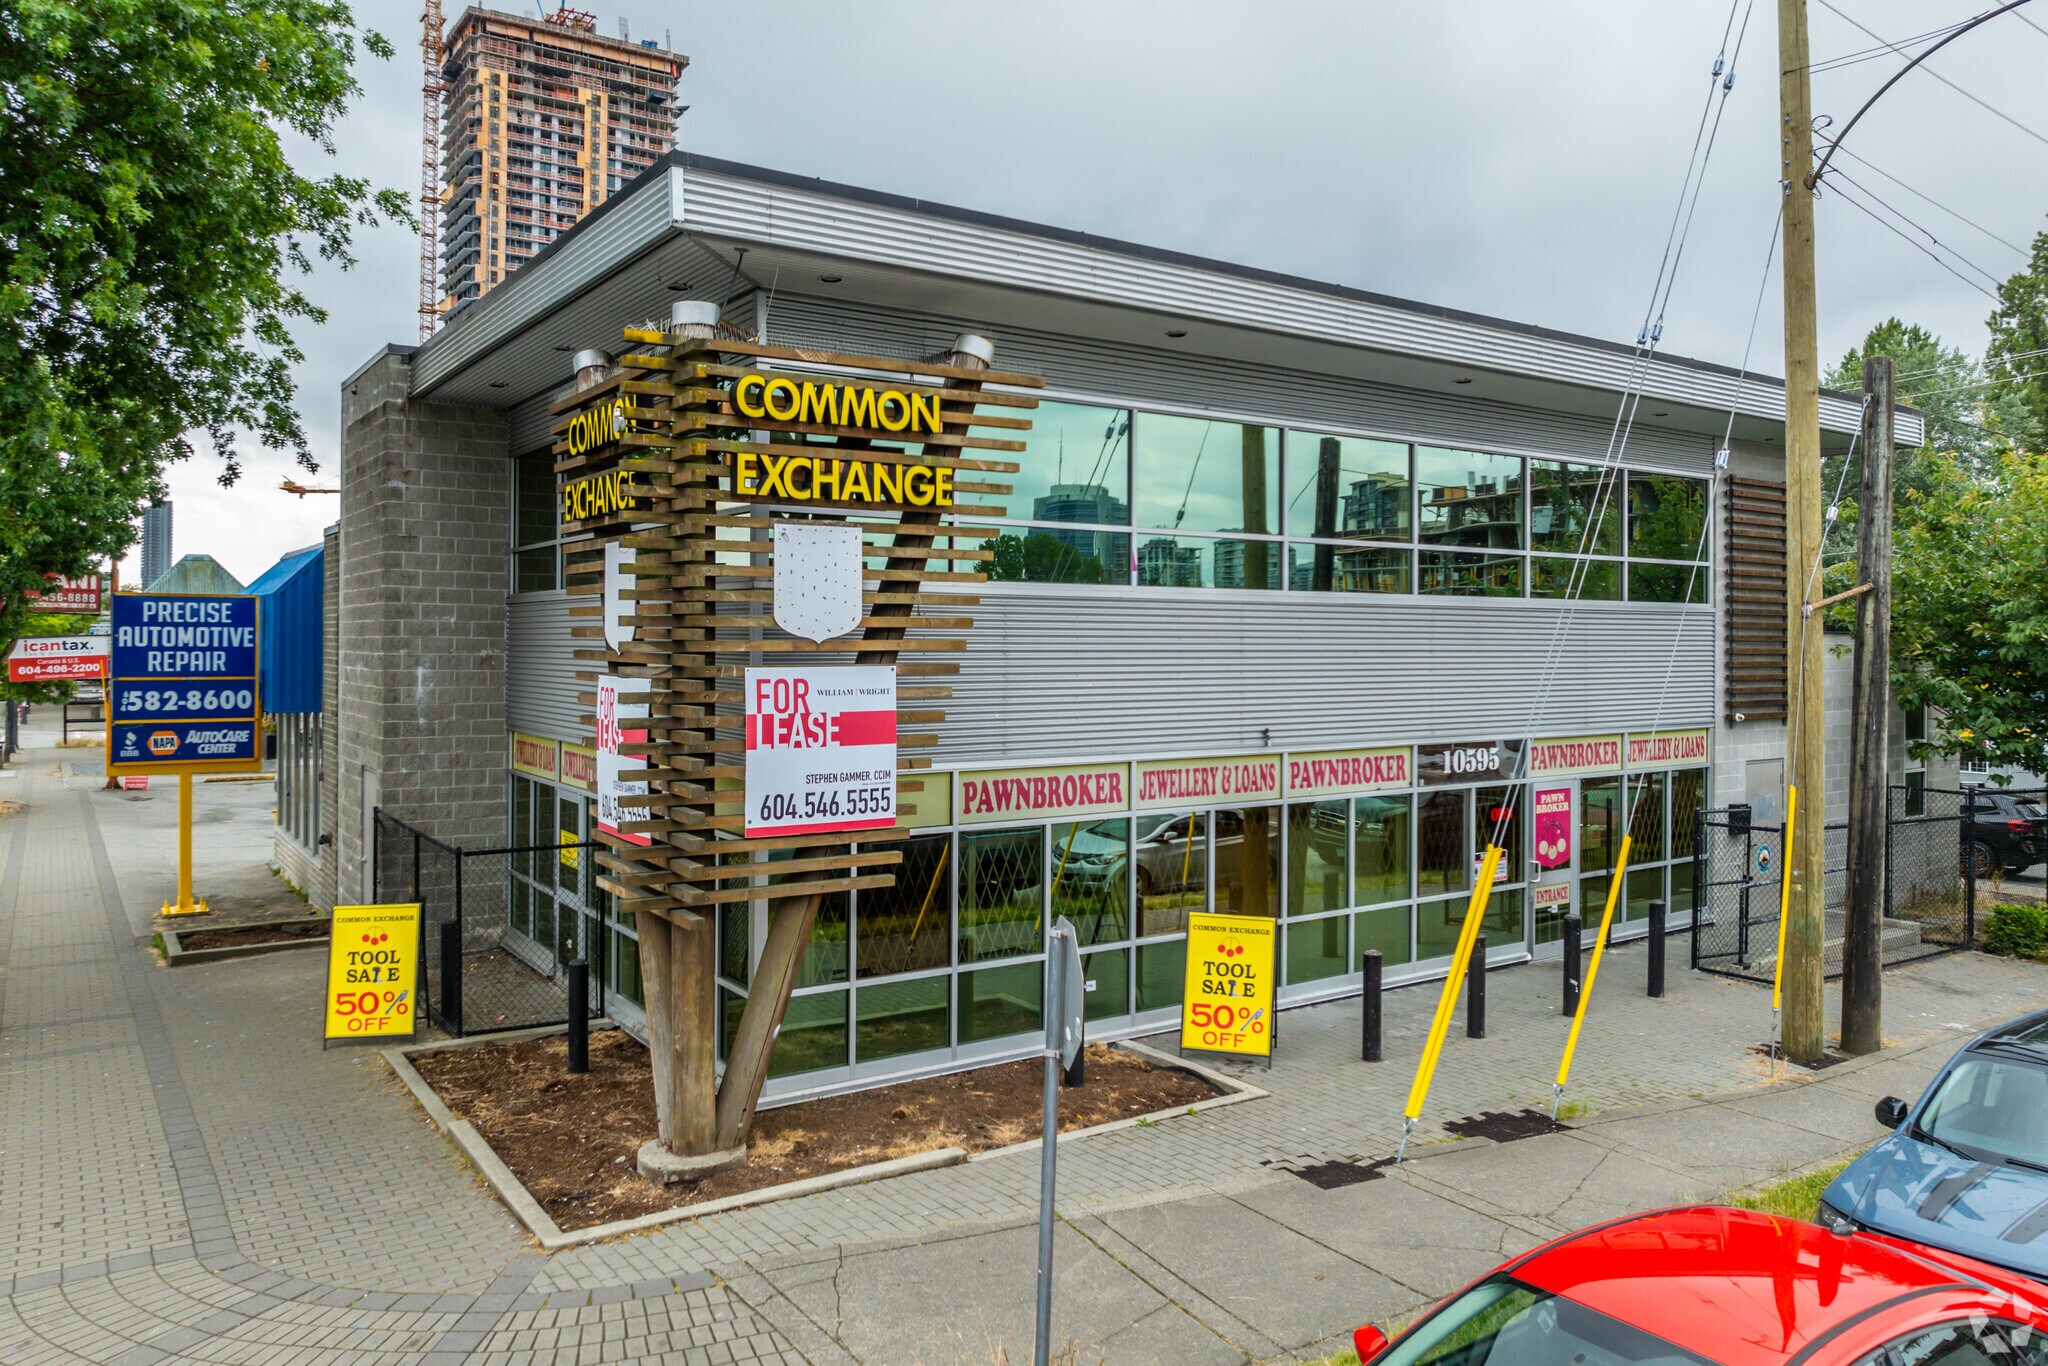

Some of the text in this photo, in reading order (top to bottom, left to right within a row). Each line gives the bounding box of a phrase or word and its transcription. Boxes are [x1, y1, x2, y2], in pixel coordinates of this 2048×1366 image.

[735, 374, 941, 434] COMMON
[736, 453, 953, 507] EXCHANGE
[142, 601, 233, 623] PRECISE
[118, 625, 254, 648] AUTOMOTIVE
[18, 663, 100, 675] 604-496-2200
[147, 650, 227, 672] REPAIR
[127, 690, 252, 711] 582-8600
[756, 678, 811, 715] FOR
[816, 688, 890, 697] WILLIAM WRIGHT
[600, 687, 615, 721] FOR
[756, 712, 841, 750] LEASE
[152, 737, 176, 749] NAPA
[197, 743, 237, 754] CENTER
[1627, 735, 1705, 762] JEWELLERY & LOANS
[1443, 747, 1500, 774] 10595
[1530, 741, 1619, 771] PAWNBROKER
[805, 772, 838, 785] STEPHEN
[874, 770, 891, 781] CCIM
[1139, 763, 1276, 801] JEWELLERY & LOANS
[1289, 754, 1407, 789] PAWNBROKER
[760, 787, 891, 821] 604.546.5555
[962, 772, 1123, 815] PAWNBROKER
[1540, 793, 1565, 804] PAWN
[1536, 802, 1570, 814] BROKER
[1536, 887, 1568, 904] ENTRANCE
[1193, 924, 1271, 936] COMMON EXCHANGE
[347, 950, 401, 966] TOOL
[1203, 961, 1256, 979] TOOL
[1202, 979, 1256, 998] SALE
[335, 989, 408, 1016] 50%
[347, 1016, 391, 1032] OFF
[1191, 1002, 1264, 1034] 50%
[1203, 1031, 1247, 1047] OFF
